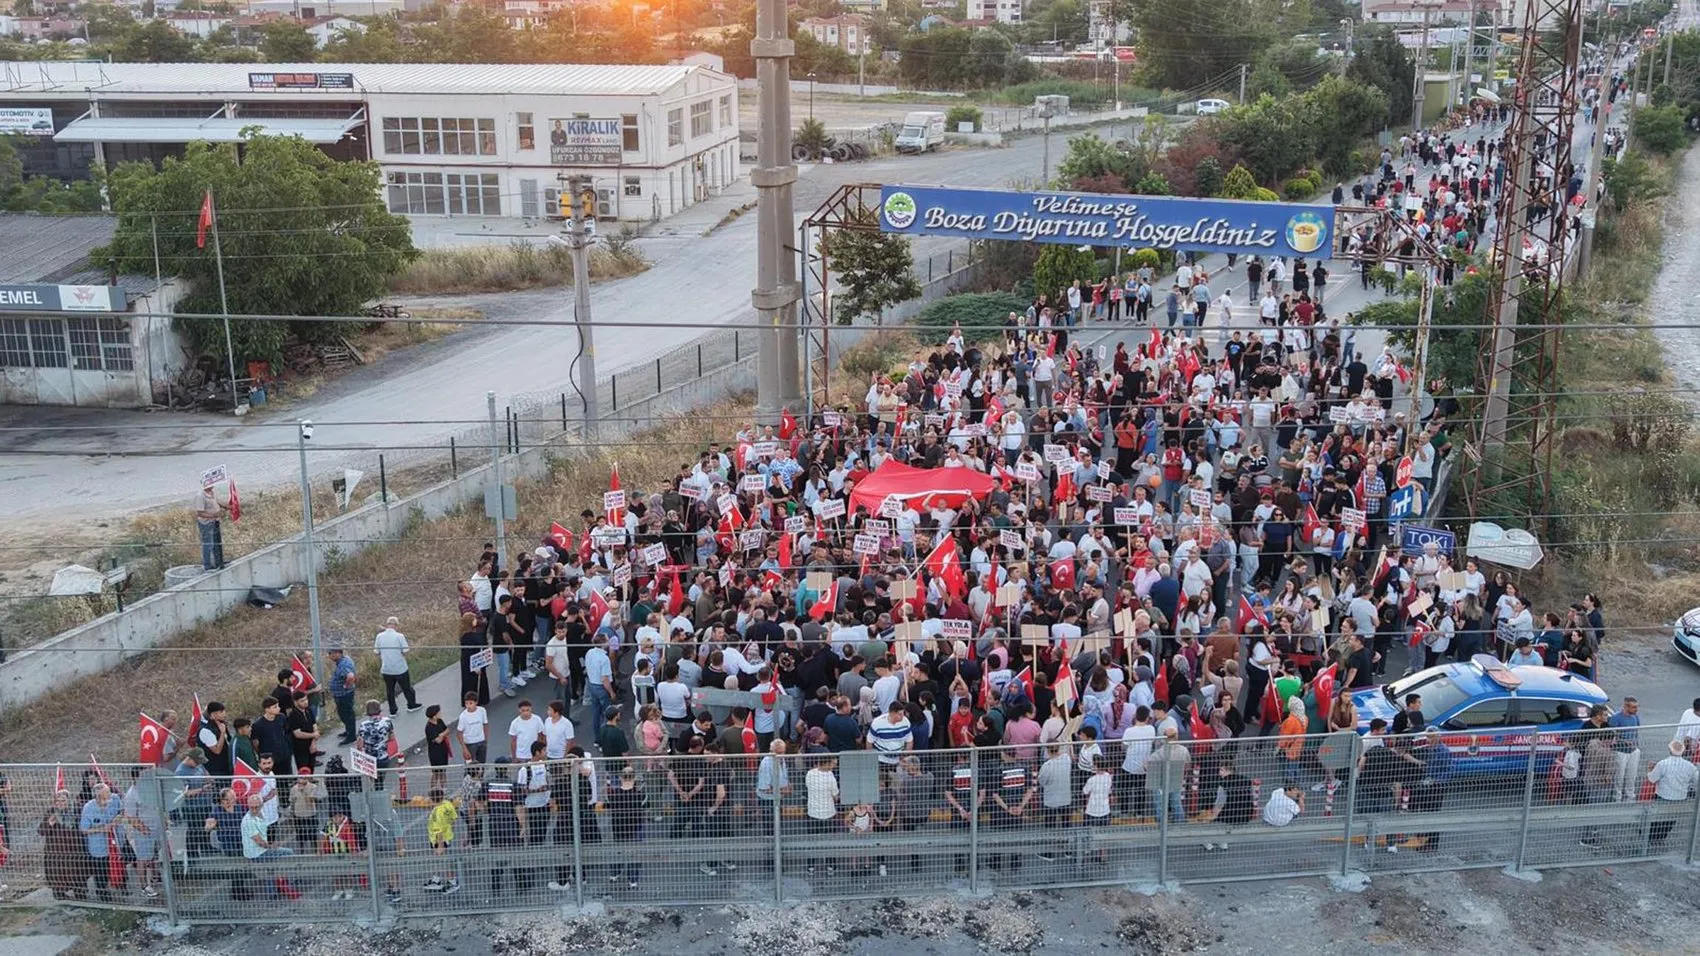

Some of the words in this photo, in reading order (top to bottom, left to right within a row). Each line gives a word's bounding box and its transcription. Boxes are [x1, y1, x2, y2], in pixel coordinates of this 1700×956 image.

[1033, 196, 1137, 220] Velimeşe
[925, 207, 987, 231] Boza
[993, 211, 1108, 240] Diyarına
[1113, 210, 1277, 249] Hoşgeldiniz
